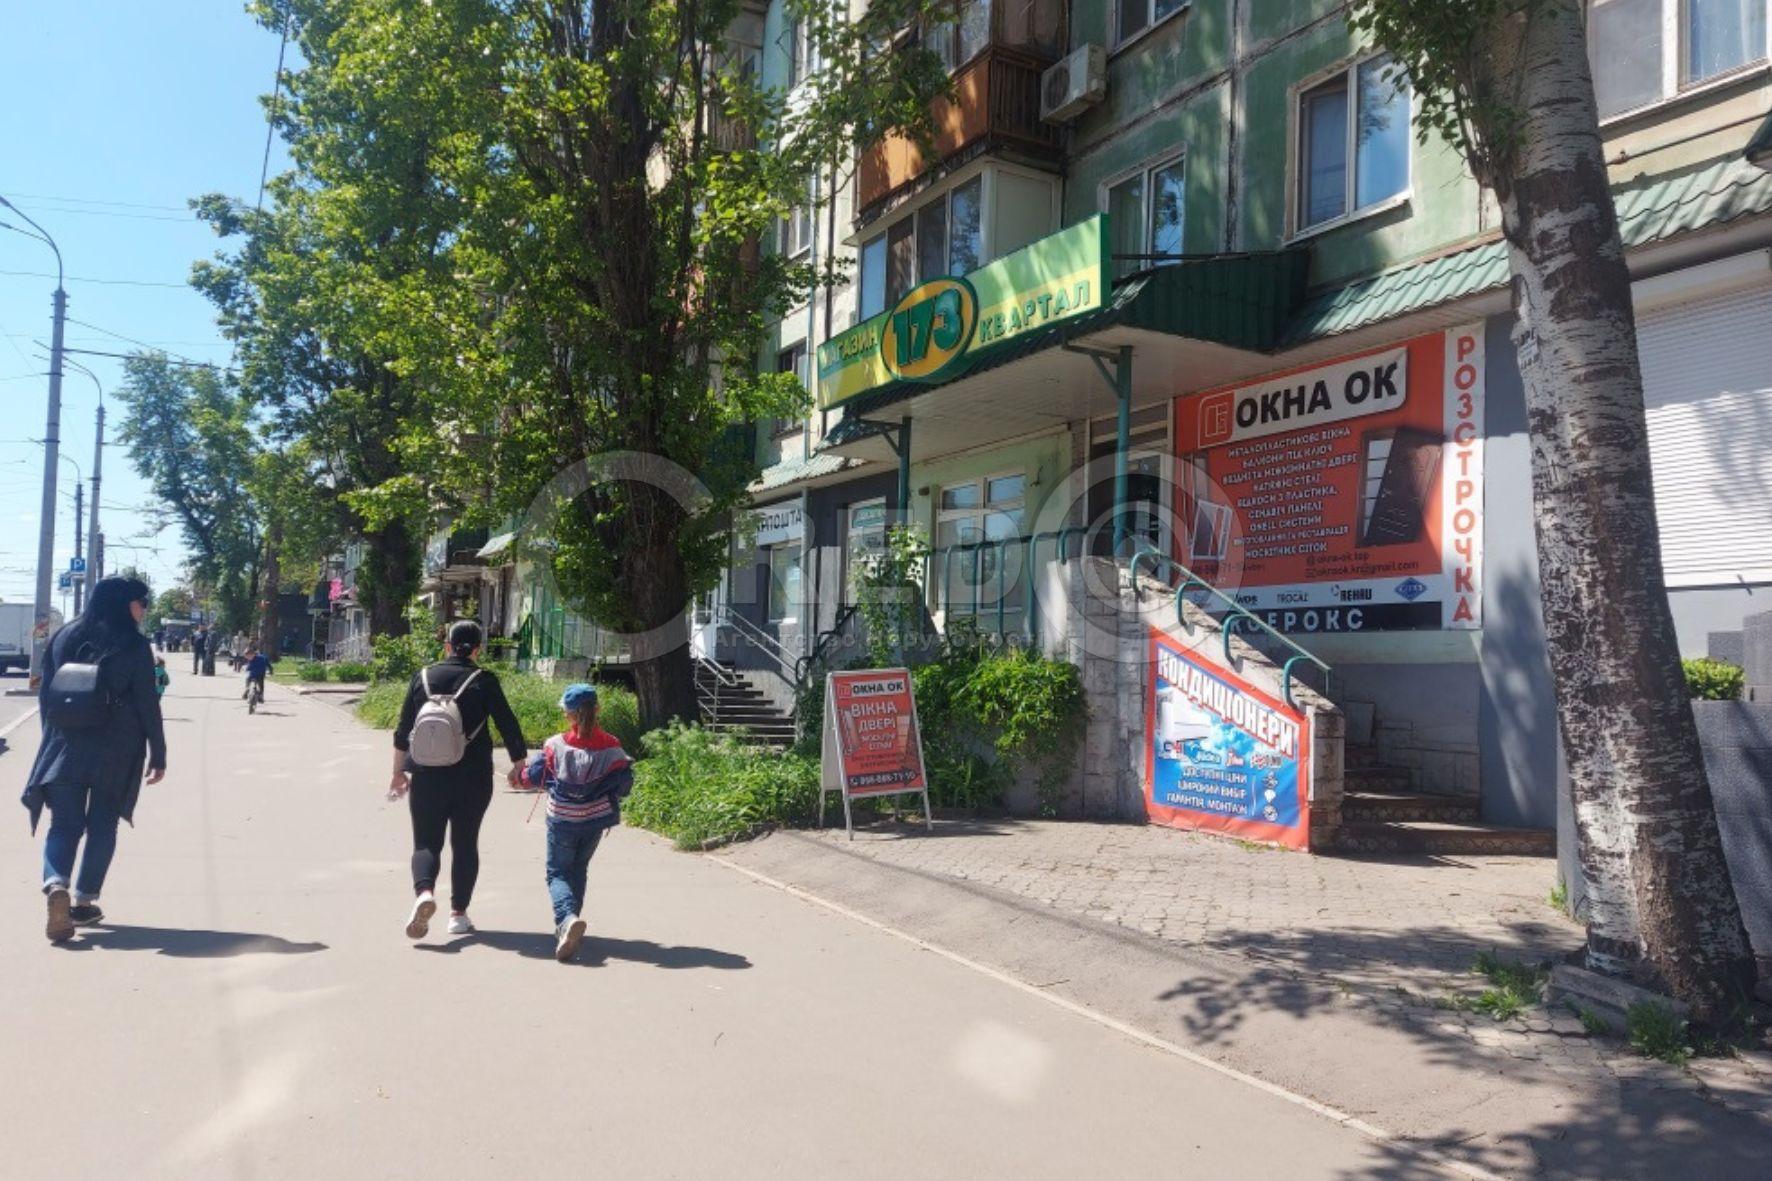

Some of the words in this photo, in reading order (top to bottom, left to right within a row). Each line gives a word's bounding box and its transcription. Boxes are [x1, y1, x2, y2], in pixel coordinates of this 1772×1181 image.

[893, 287, 965, 367] 173
[979, 279, 1091, 343] КВАРТАЛ
[1236, 380, 1332, 428] ОКНА
[1344, 362, 1398, 404] ОК
[1452, 335, 1477, 622] РОЗСТРОЧКА
[1340, 588, 1372, 601] REHAU
[851, 701, 897, 718] ВІКНА
[853, 683, 884, 695] ОКНА
[887, 682, 903, 691] ОК
[1158, 648, 1294, 758] КОНДИЦІОНЕРИ
[858, 718, 896, 733] ДВЕРІ
